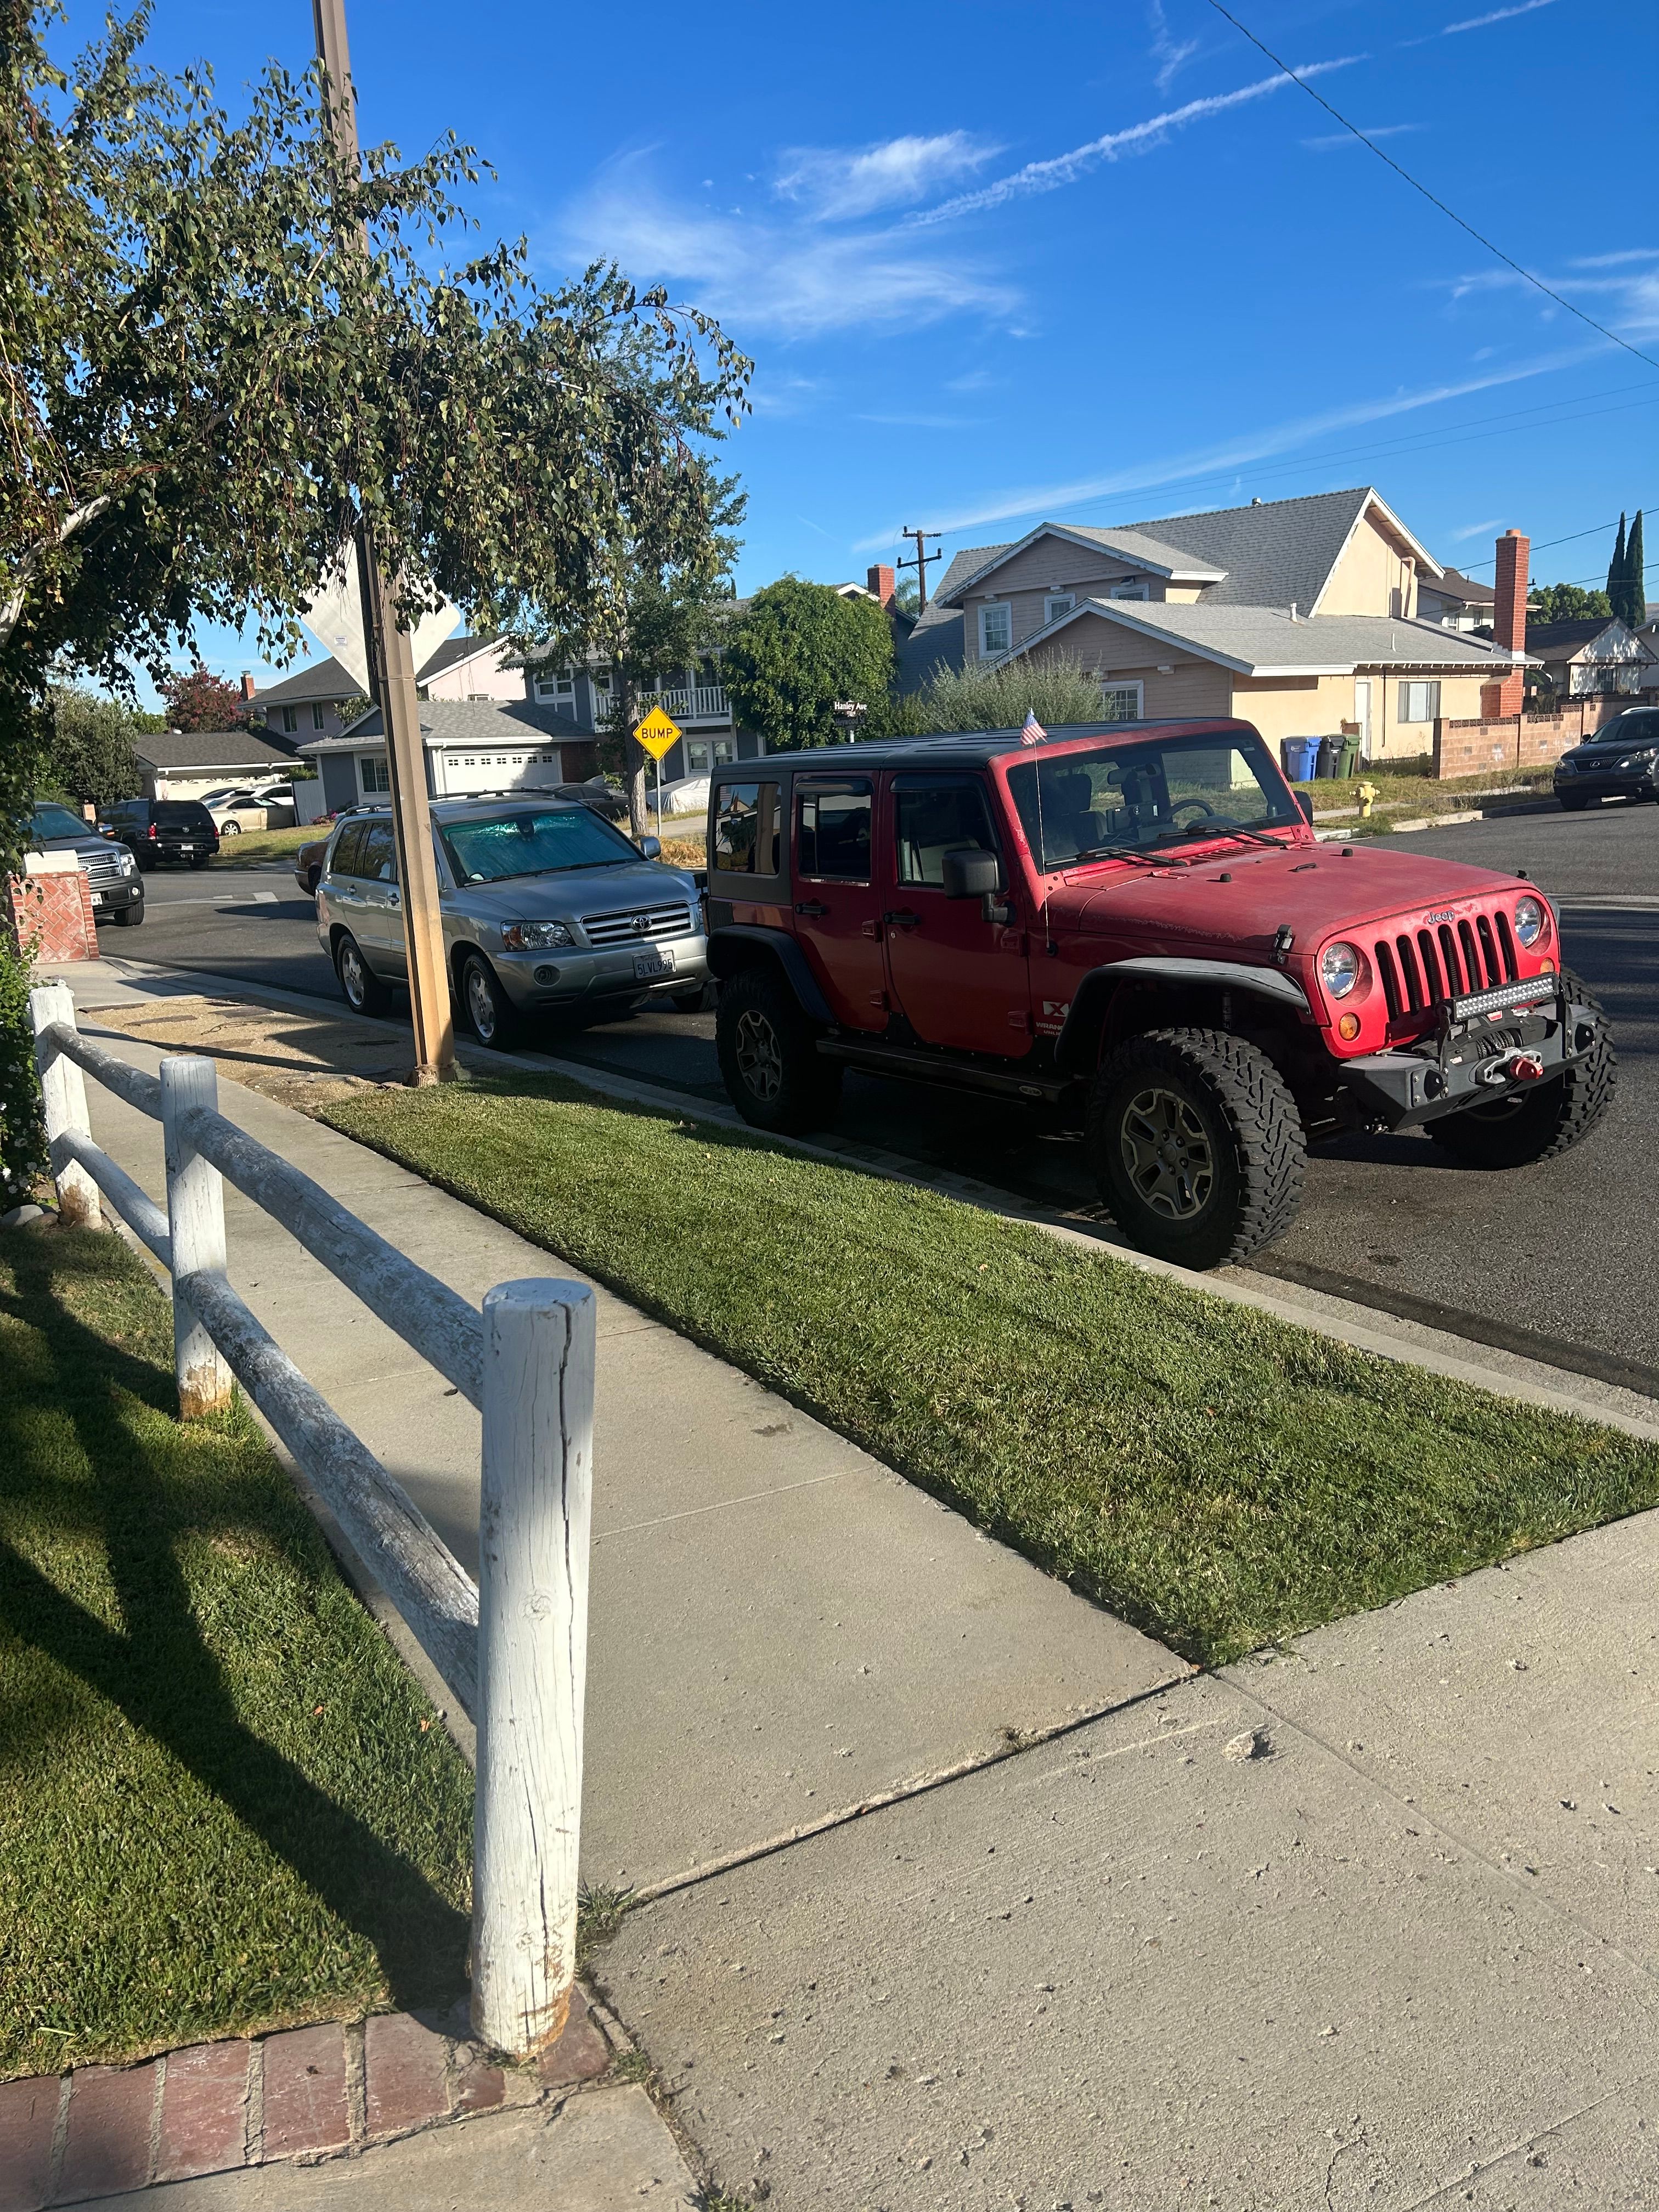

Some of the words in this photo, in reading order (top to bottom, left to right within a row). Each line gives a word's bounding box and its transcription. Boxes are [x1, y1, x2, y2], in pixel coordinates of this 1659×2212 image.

[834, 701, 855, 711] Hanley
[641, 728, 673, 739] BUMP
[1427, 910, 1455, 925] Jeep
[637, 958, 673, 975] 5LVL995
[1047, 1002, 1066, 1017] X
